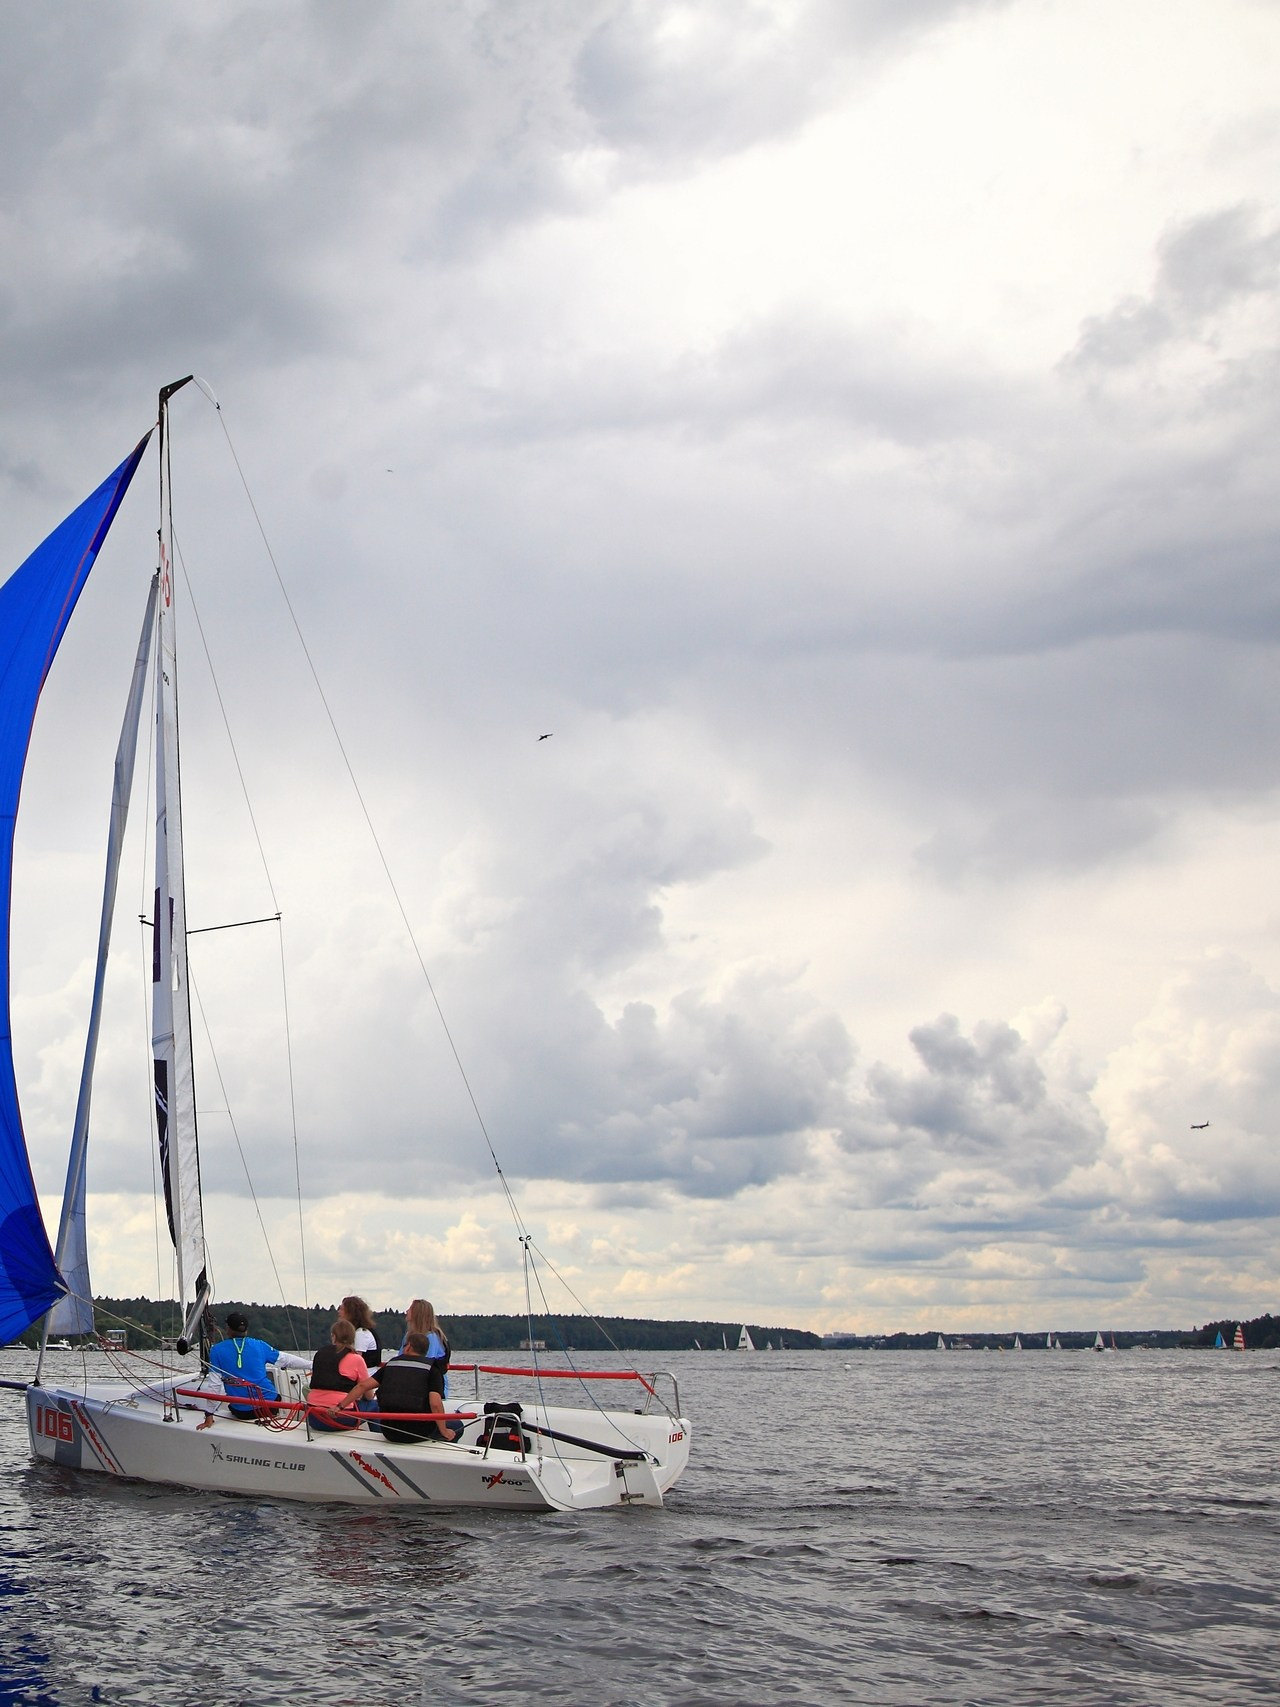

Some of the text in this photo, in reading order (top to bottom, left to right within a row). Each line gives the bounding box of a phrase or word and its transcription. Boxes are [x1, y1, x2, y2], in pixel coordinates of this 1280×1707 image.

[36, 1405, 73, 1443] 106
[668, 1431, 683, 1444] 106
[226, 1454, 271, 1467] SAILING
[274, 1461, 306, 1471] CLUB
